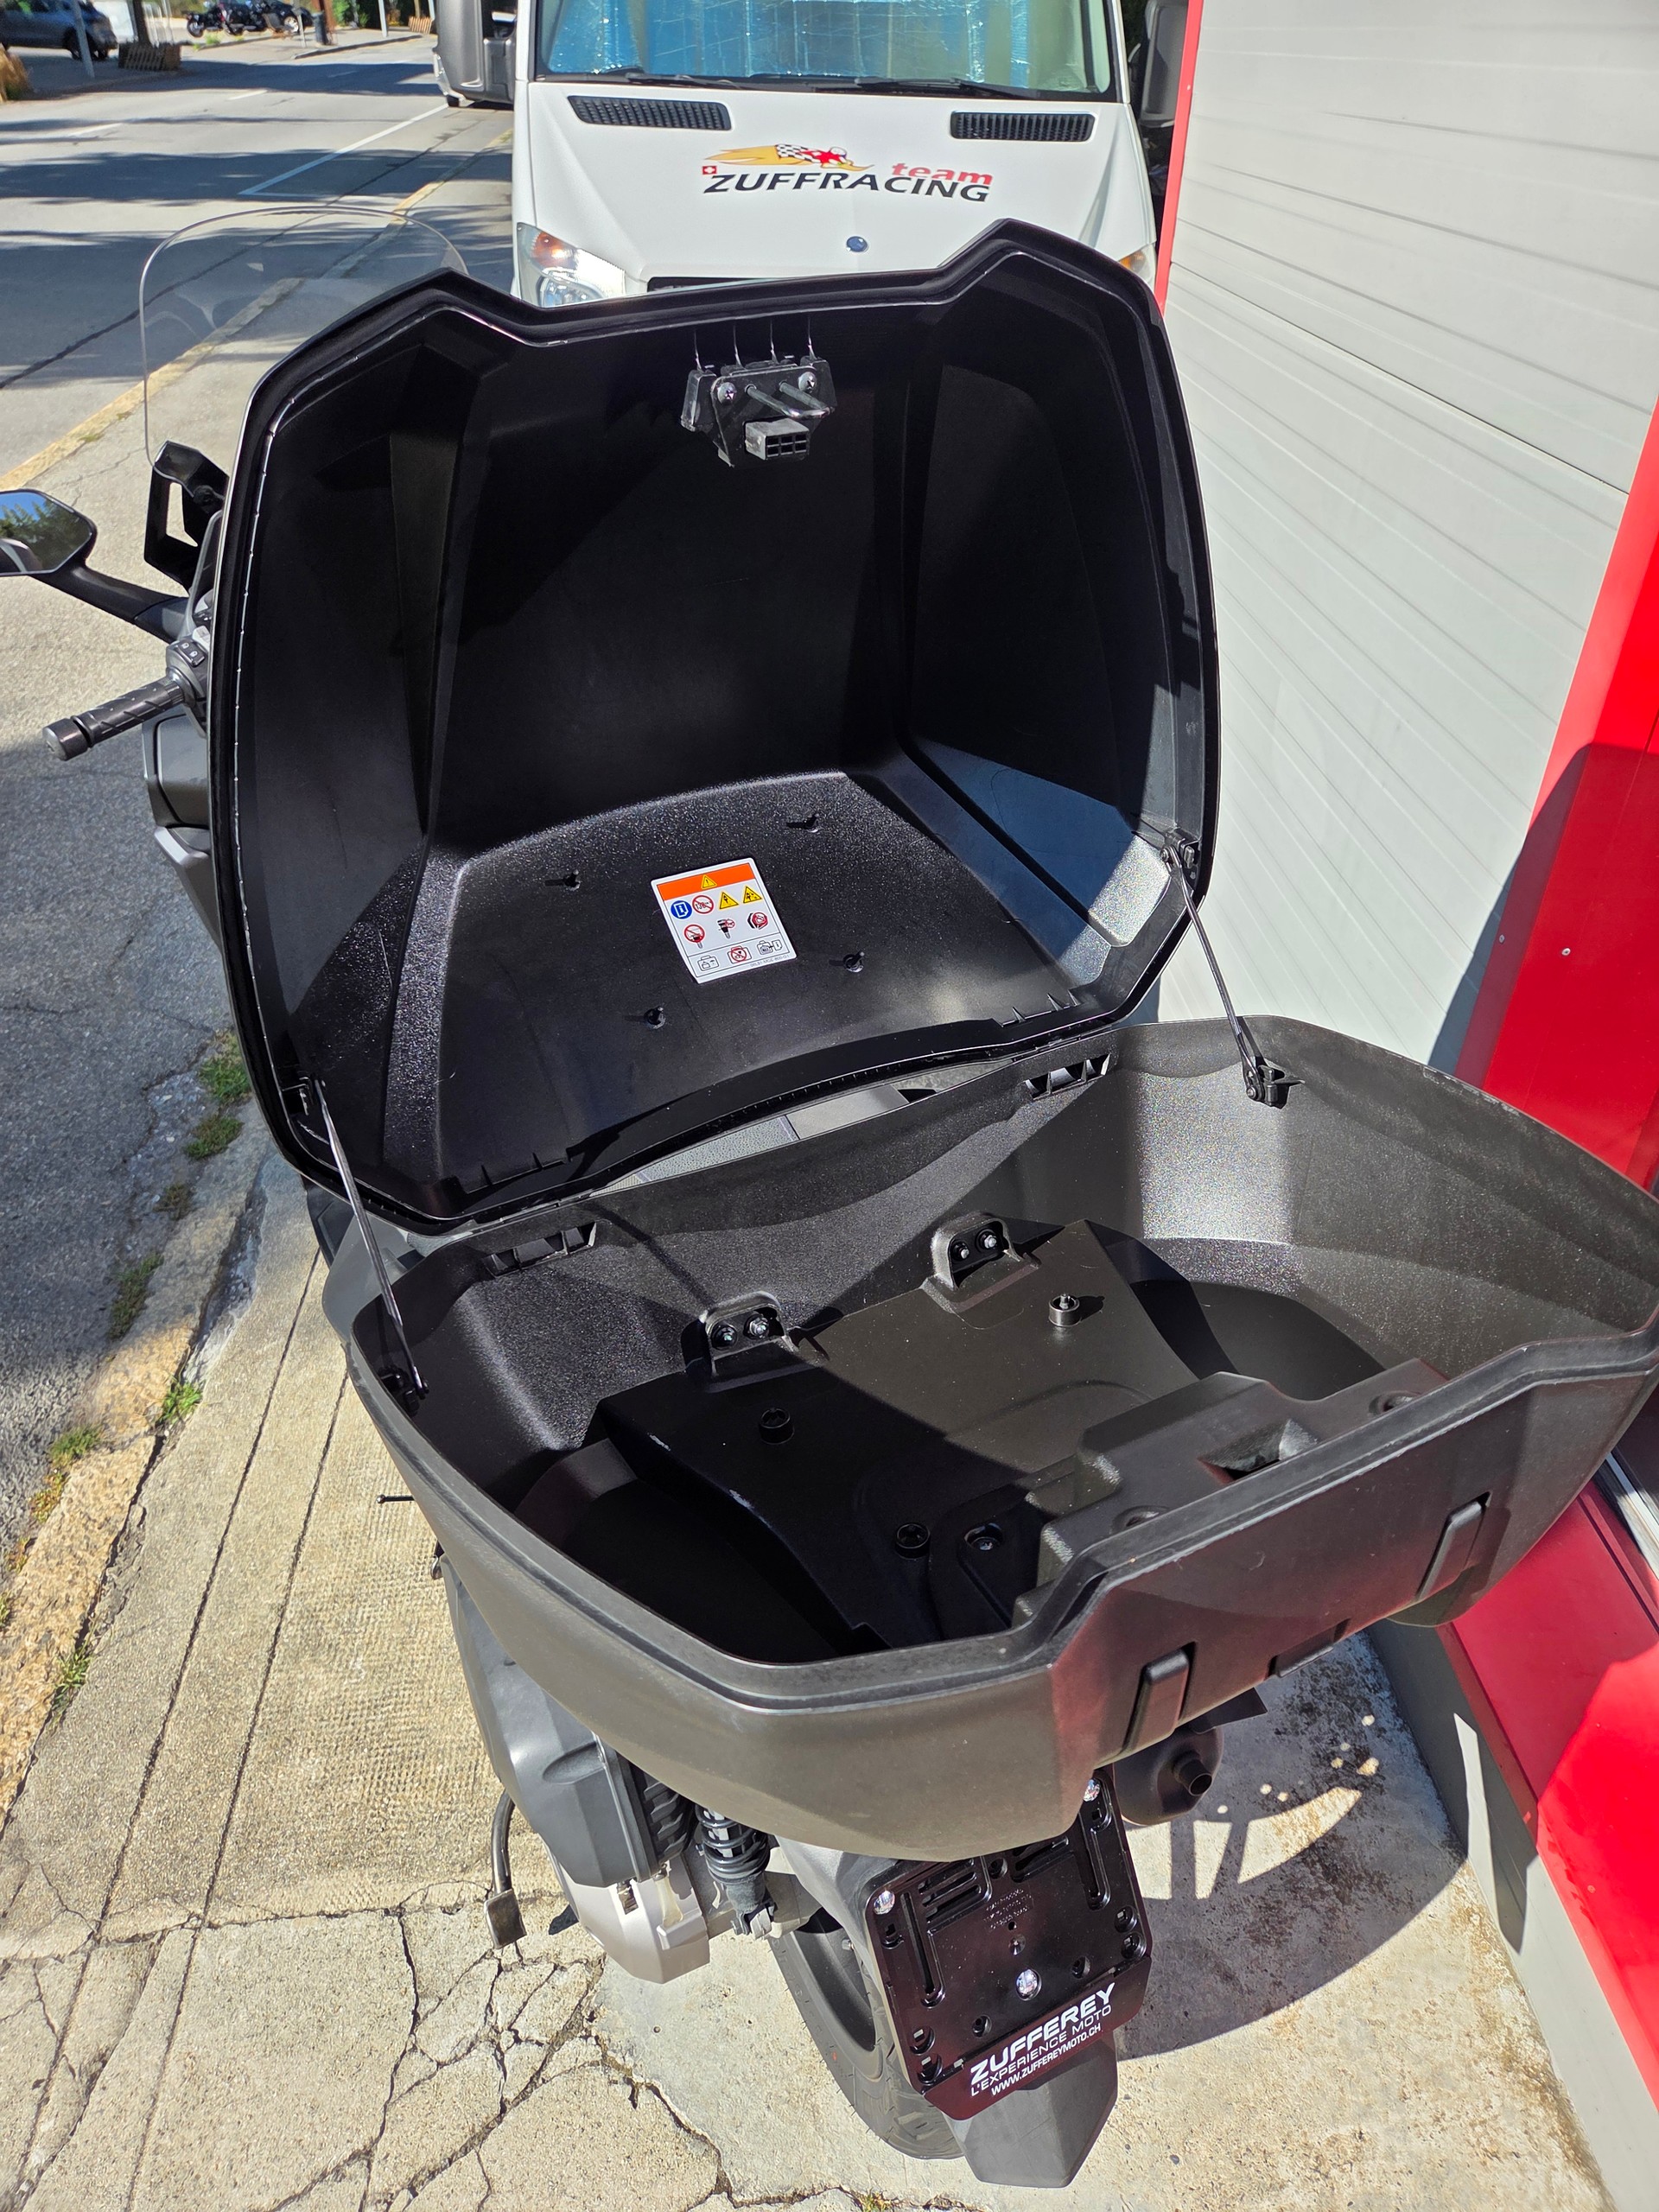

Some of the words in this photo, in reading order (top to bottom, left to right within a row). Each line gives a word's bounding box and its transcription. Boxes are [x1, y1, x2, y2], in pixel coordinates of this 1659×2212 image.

[703, 173, 989, 202] ZUFFRACING
[892, 162, 993, 185] team
[970, 1982, 1116, 2085] ZUFFEREY
[970, 2031, 1067, 2097] L'EXPERIENCE
[1071, 2004, 1112, 2036] MOTO
[991, 2023, 1102, 2096] WWW.ZUFFEREYMOTO.CH
